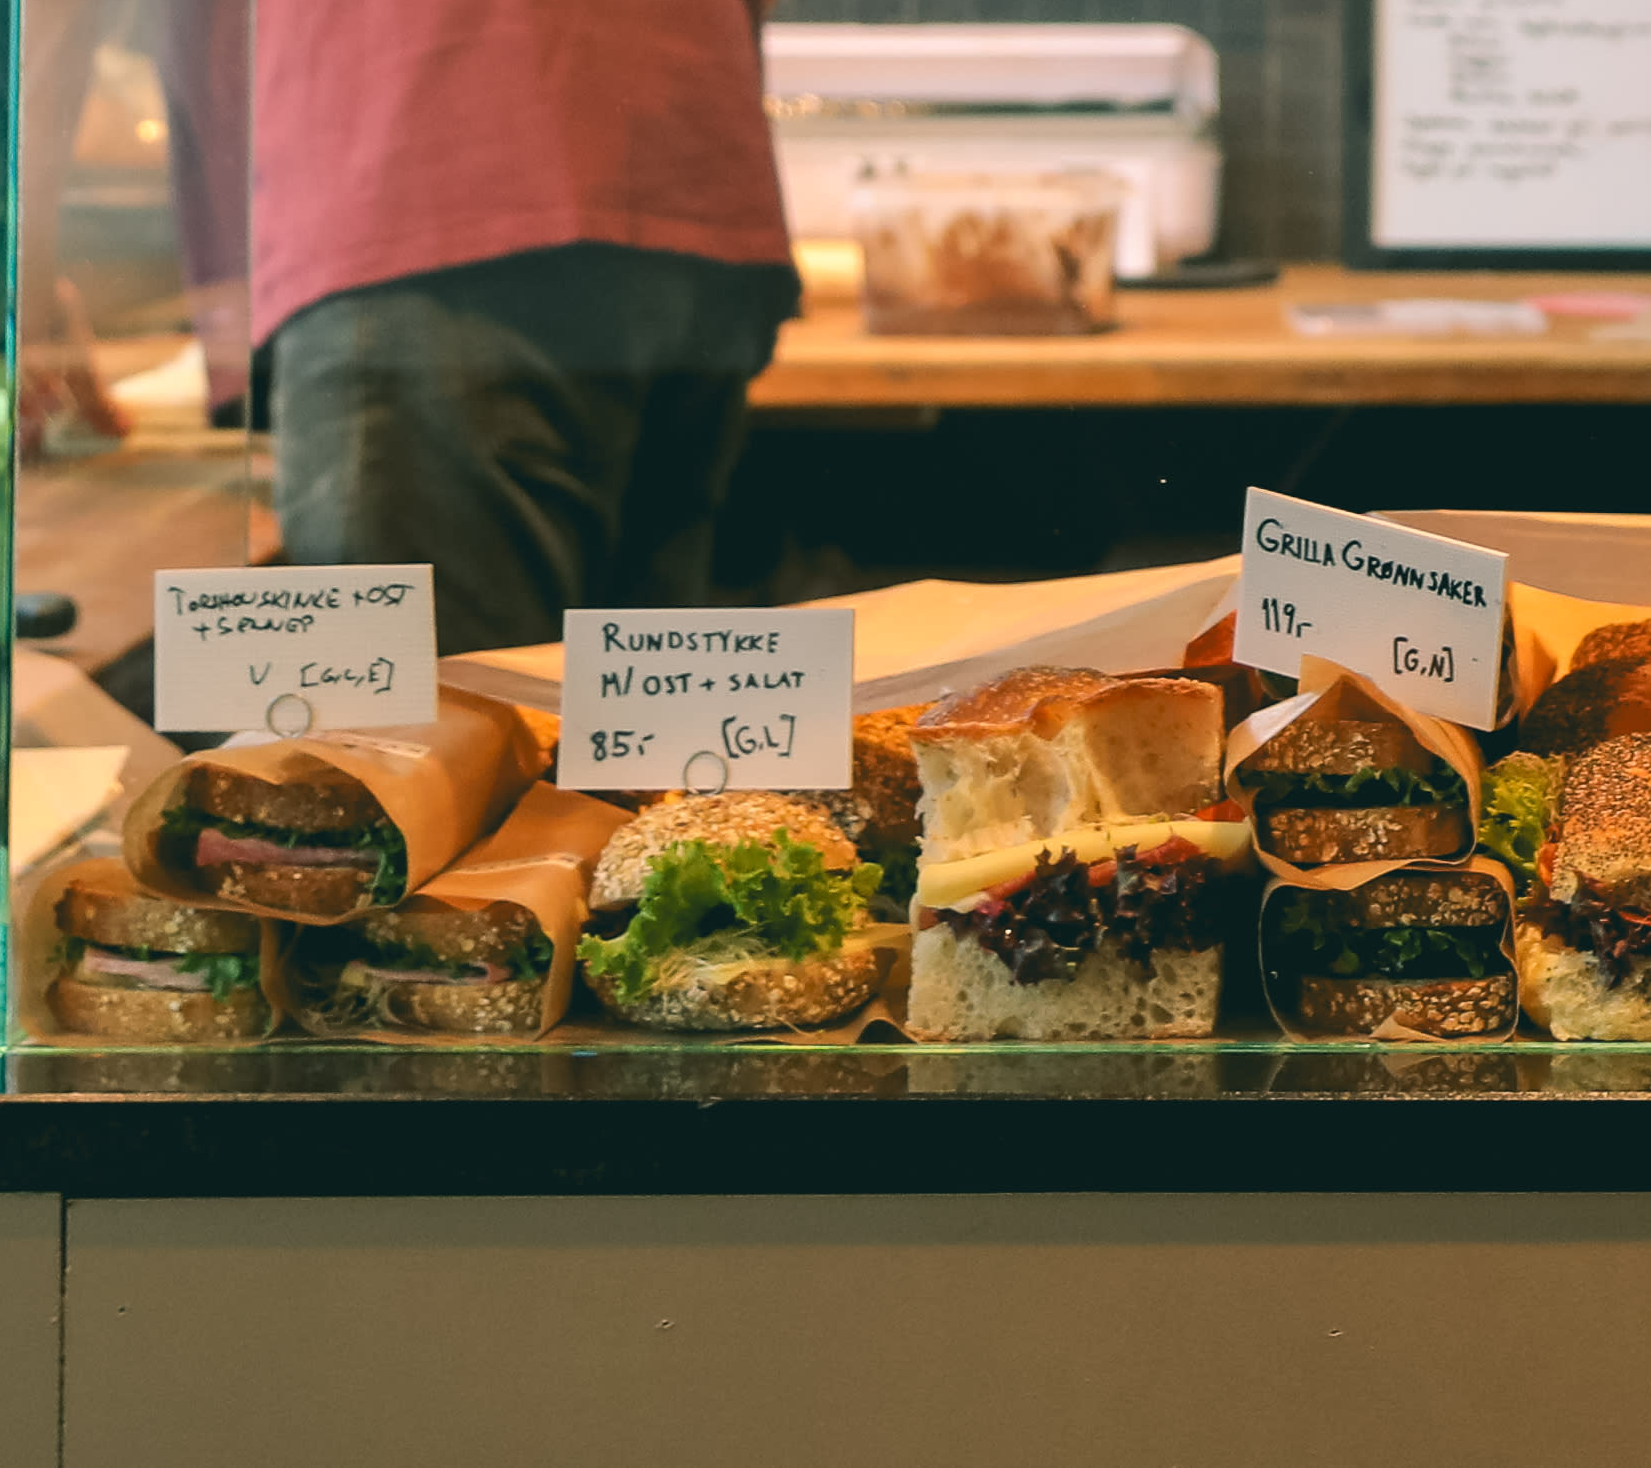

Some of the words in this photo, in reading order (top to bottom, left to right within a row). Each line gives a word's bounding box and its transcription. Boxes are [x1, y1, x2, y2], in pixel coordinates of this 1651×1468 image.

[1256, 518, 1336, 567] GRILLA
[602, 623, 780, 653] RUNDSTYKKE
[728, 671, 806, 692] SALAT
